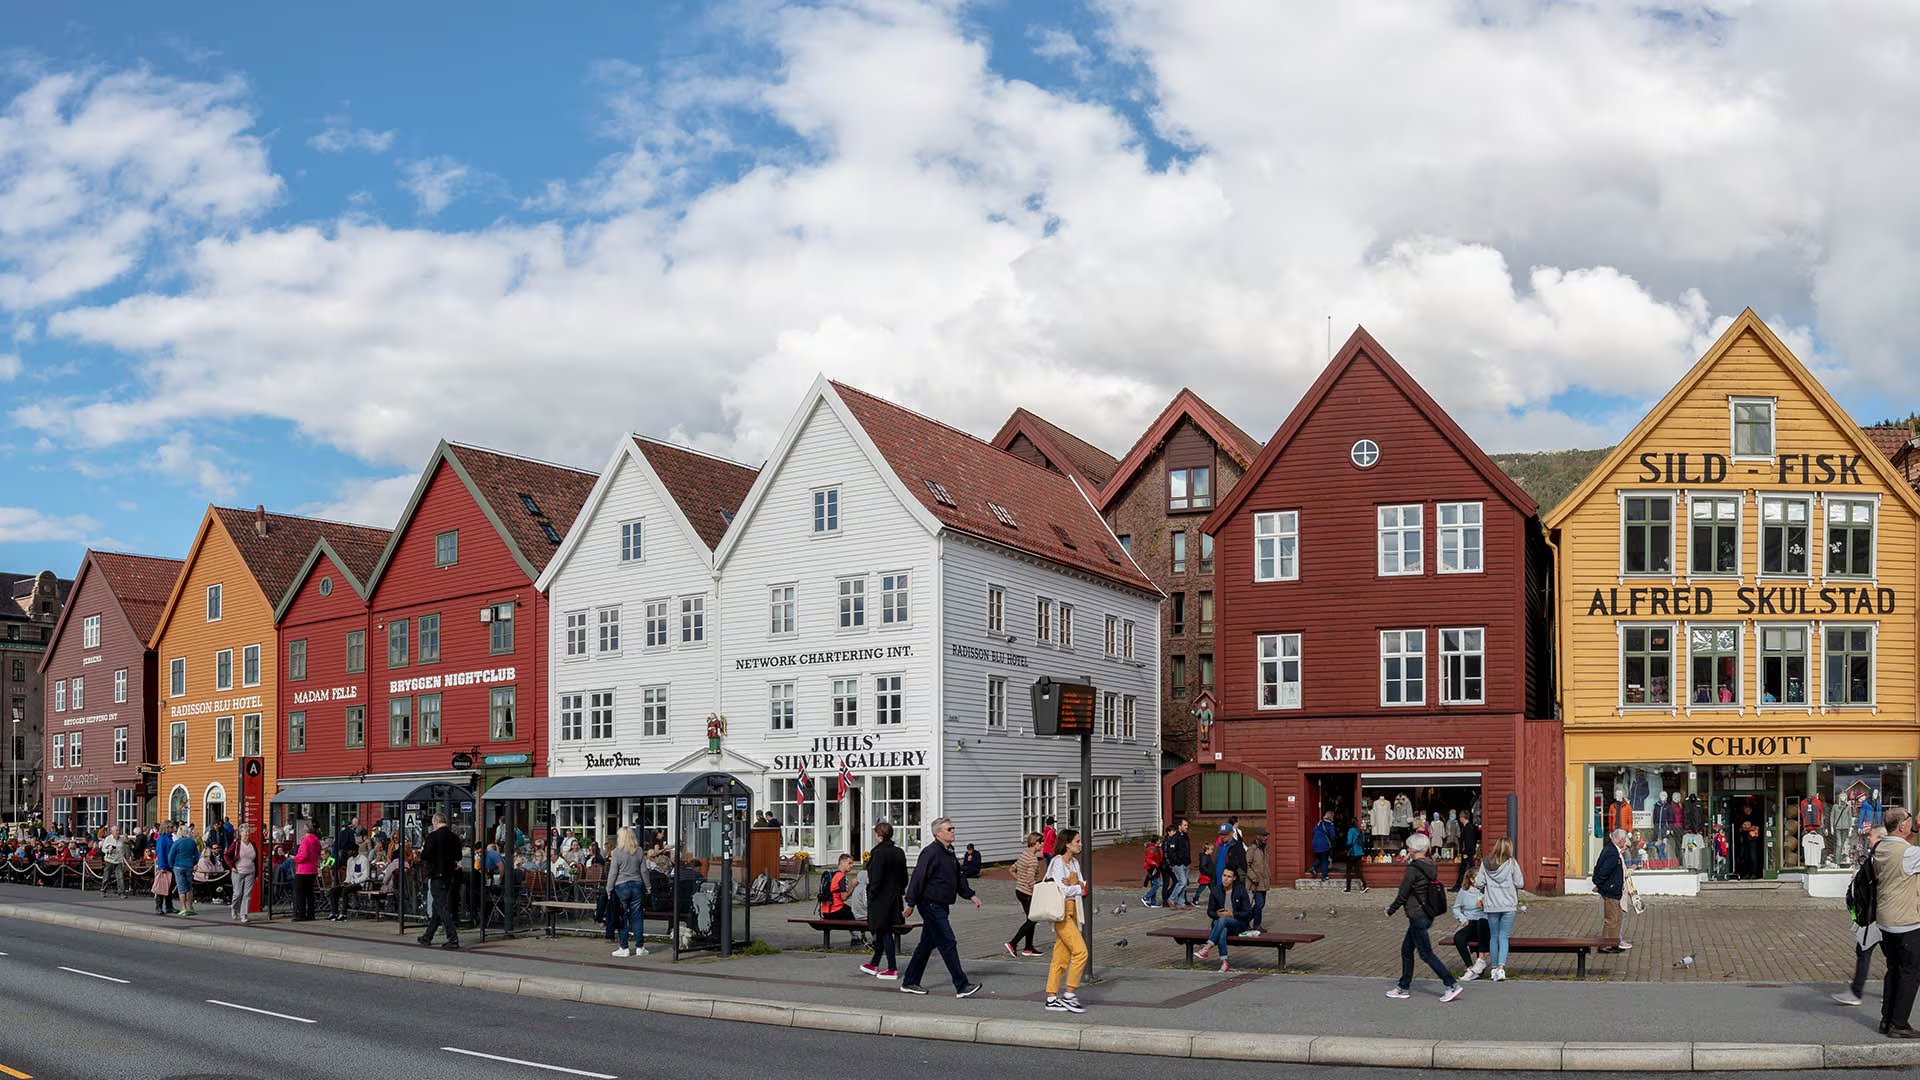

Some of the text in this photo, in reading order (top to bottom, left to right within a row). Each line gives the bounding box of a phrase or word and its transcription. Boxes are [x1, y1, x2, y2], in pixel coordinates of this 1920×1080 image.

[1639, 453, 1727, 484] SILD
[1778, 453, 1863, 485] FISK
[1588, 586, 1896, 616] ALFRED SKULSTAD
[735, 645, 914, 670] NETWORK CHARTERING INT.
[952, 644, 1029, 668] RADISSON BLU HOTEL
[390, 667, 516, 693] BRYGGEN NIGHTCLUB
[293, 685, 357, 704] MADAM FELLE
[171, 695, 263, 718] RADISSON BLU HOTEL
[1692, 736, 1812, 757] SCHJØTT
[249, 762, 258, 774] A
[845, 749, 927, 768] GALLERY
[406, 814, 415, 826] A
